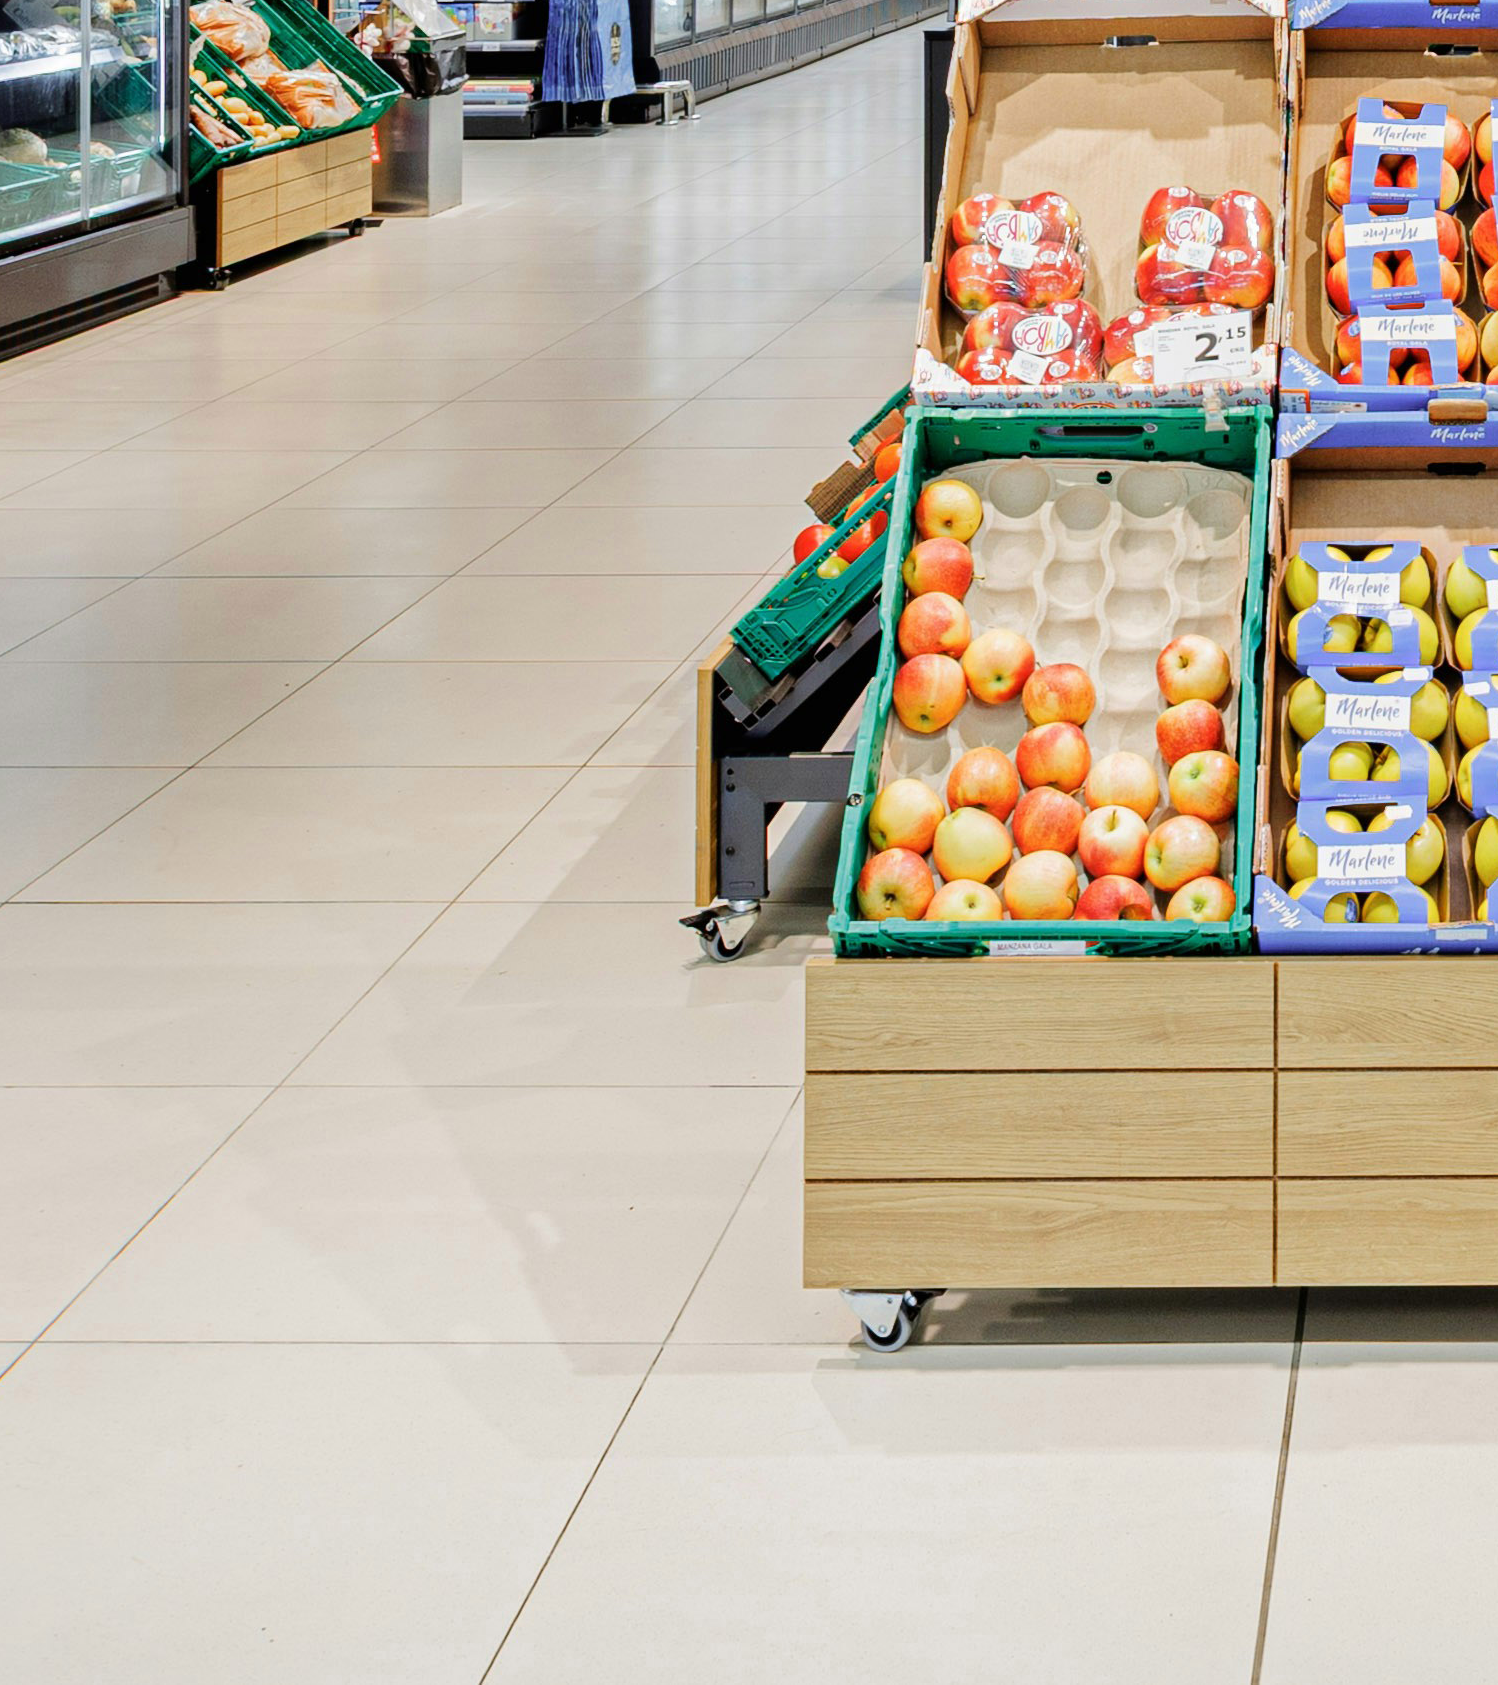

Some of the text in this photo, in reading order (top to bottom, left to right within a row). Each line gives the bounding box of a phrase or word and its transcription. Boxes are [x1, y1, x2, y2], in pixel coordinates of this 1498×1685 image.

[1432, 8, 1482, 21] Marlene
[1373, 124, 1429, 144] Marlene
[1363, 225, 1418, 243] Marlene
[1378, 317, 1435, 336] Marlene
[1194, 326, 1247, 363] 2,15
[1281, 415, 1318, 448] Marlene
[1430, 426, 1486, 441] Marlene
[1329, 574, 1390, 601] Marlene
[1336, 697, 1400, 720] Marlene
[1331, 728, 1403, 737] GOLDEN DELICIOUS
[1329, 852, 1395, 876] Marlene
[1324, 877, 1399, 886] GOLDEN DELICIOUS
[997, 943, 1032, 951] MANZANA
